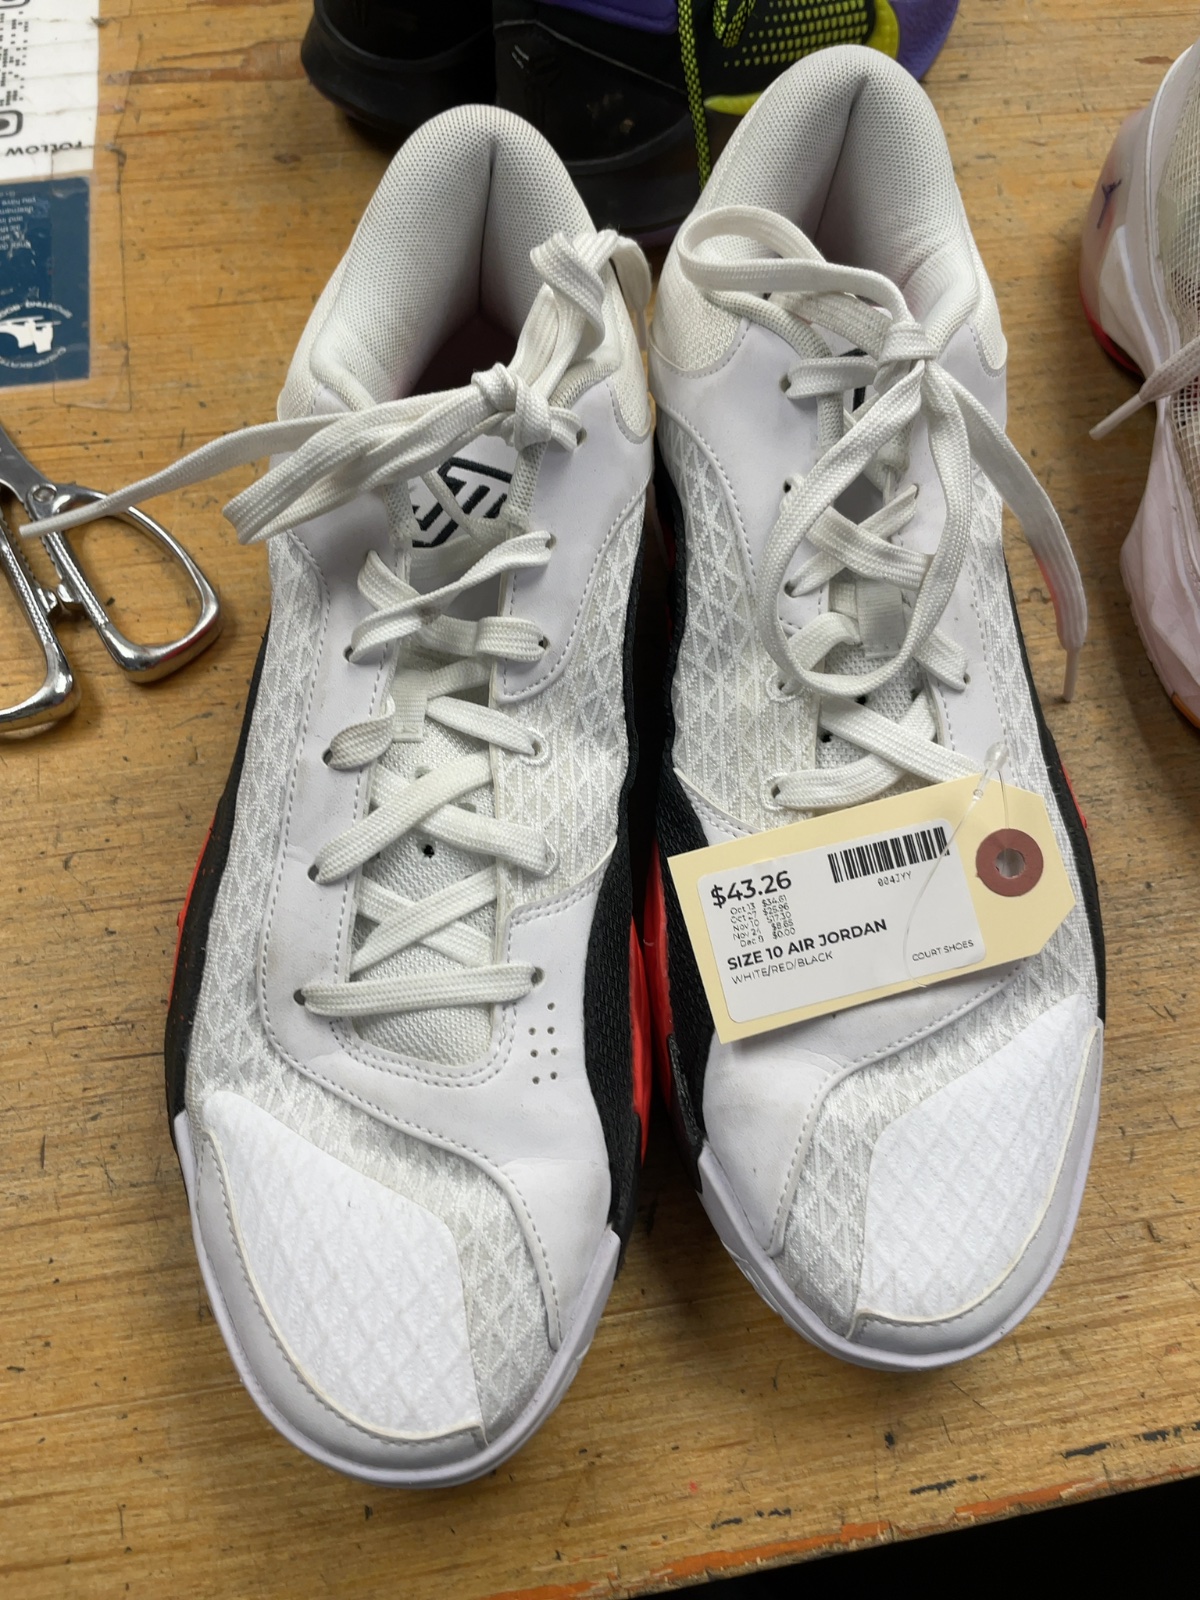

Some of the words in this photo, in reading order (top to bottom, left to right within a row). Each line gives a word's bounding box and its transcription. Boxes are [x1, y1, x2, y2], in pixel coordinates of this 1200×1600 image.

[5, 141, 82, 156] FOLLOW
[711, 870, 792, 908] $43.26
[730, 906, 746, 915] Oct
[762, 894, 787, 907] $34.61
[730, 914, 746, 924] Oct
[763, 902, 790, 916] $25.96
[733, 923, 749, 932] Nov
[750, 919, 760, 927] 10
[766, 911, 792, 923] $17.30
[733, 931, 749, 940] Nov
[771, 919, 794, 931] $8.65
[727, 950, 763, 970] SIZE
[765, 945, 783, 960] 10
[788, 937, 815, 955] AIR
[818, 918, 887, 947] JORDAN
[740, 938, 756, 947] Dec
[773, 927, 796, 940] $0.00
[912, 947, 942, 961] COURT
[943, 939, 974, 954] SHOES
[732, 950, 834, 985] WHITE/RED/BLACK
